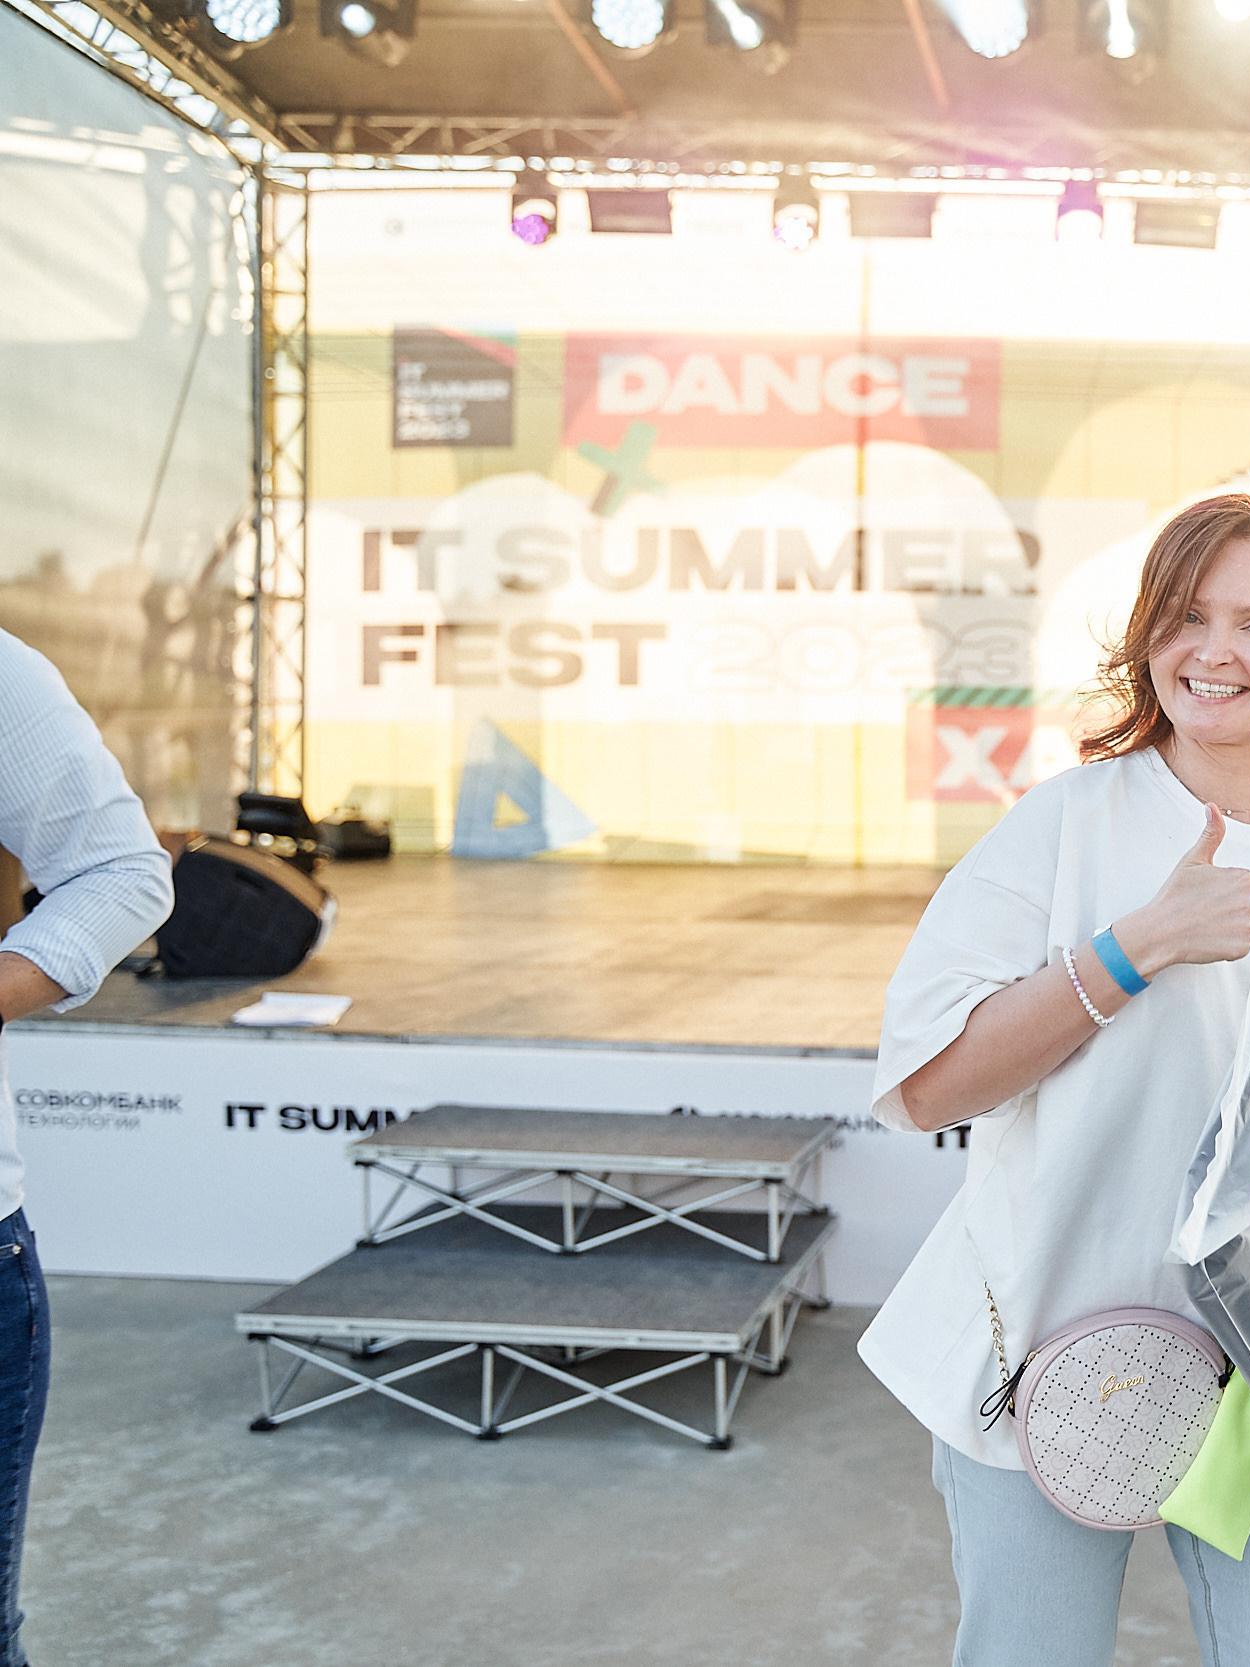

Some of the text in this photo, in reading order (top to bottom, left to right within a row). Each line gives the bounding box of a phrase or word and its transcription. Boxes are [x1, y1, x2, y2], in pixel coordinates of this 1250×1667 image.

[598, 352, 970, 418] DANCE
[362, 527, 1042, 594] IT SUMMER
[361, 616, 1037, 694] FEST 2023
[226, 1105, 264, 1128] IT
